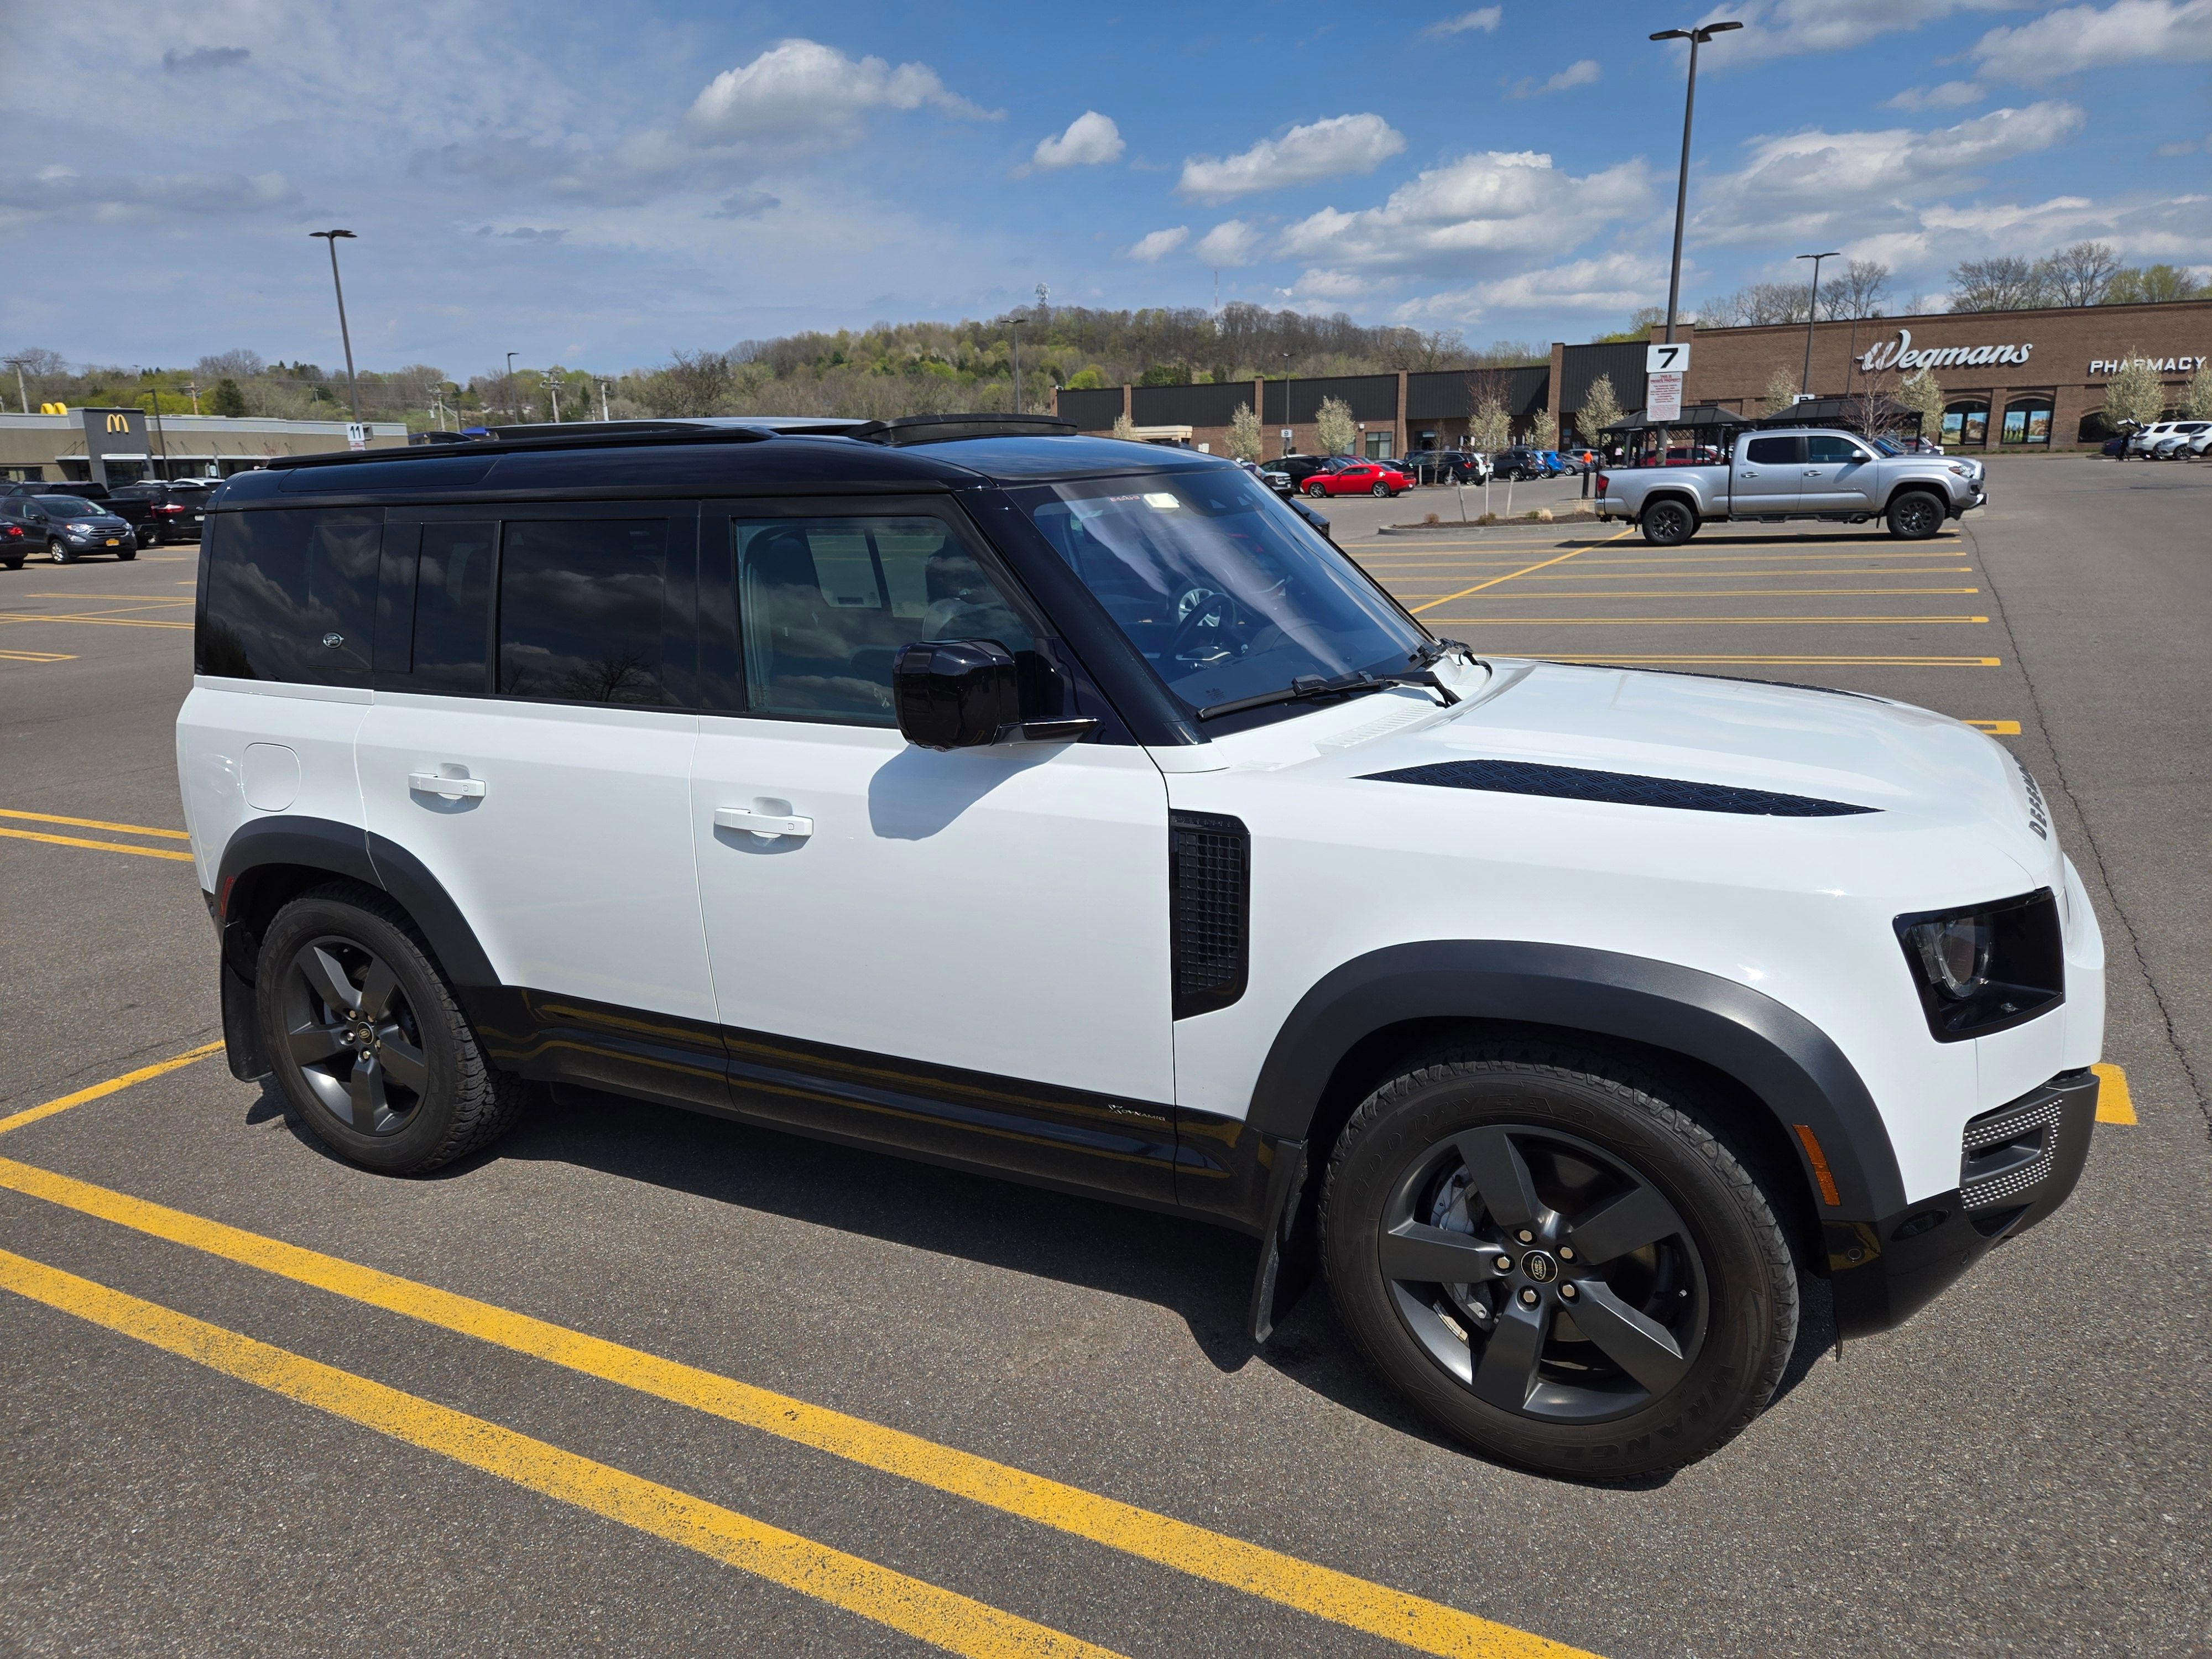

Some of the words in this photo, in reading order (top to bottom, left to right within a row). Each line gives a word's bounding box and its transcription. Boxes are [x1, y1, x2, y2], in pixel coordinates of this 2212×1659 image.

[1658, 347, 1679, 369] 7
[1856, 330, 2033, 385] Wegmans
[2090, 356, 2207, 373] PHARMACY
[350, 426, 361, 439] 11
[1478, 1364, 1736, 1463] WRANGLER
